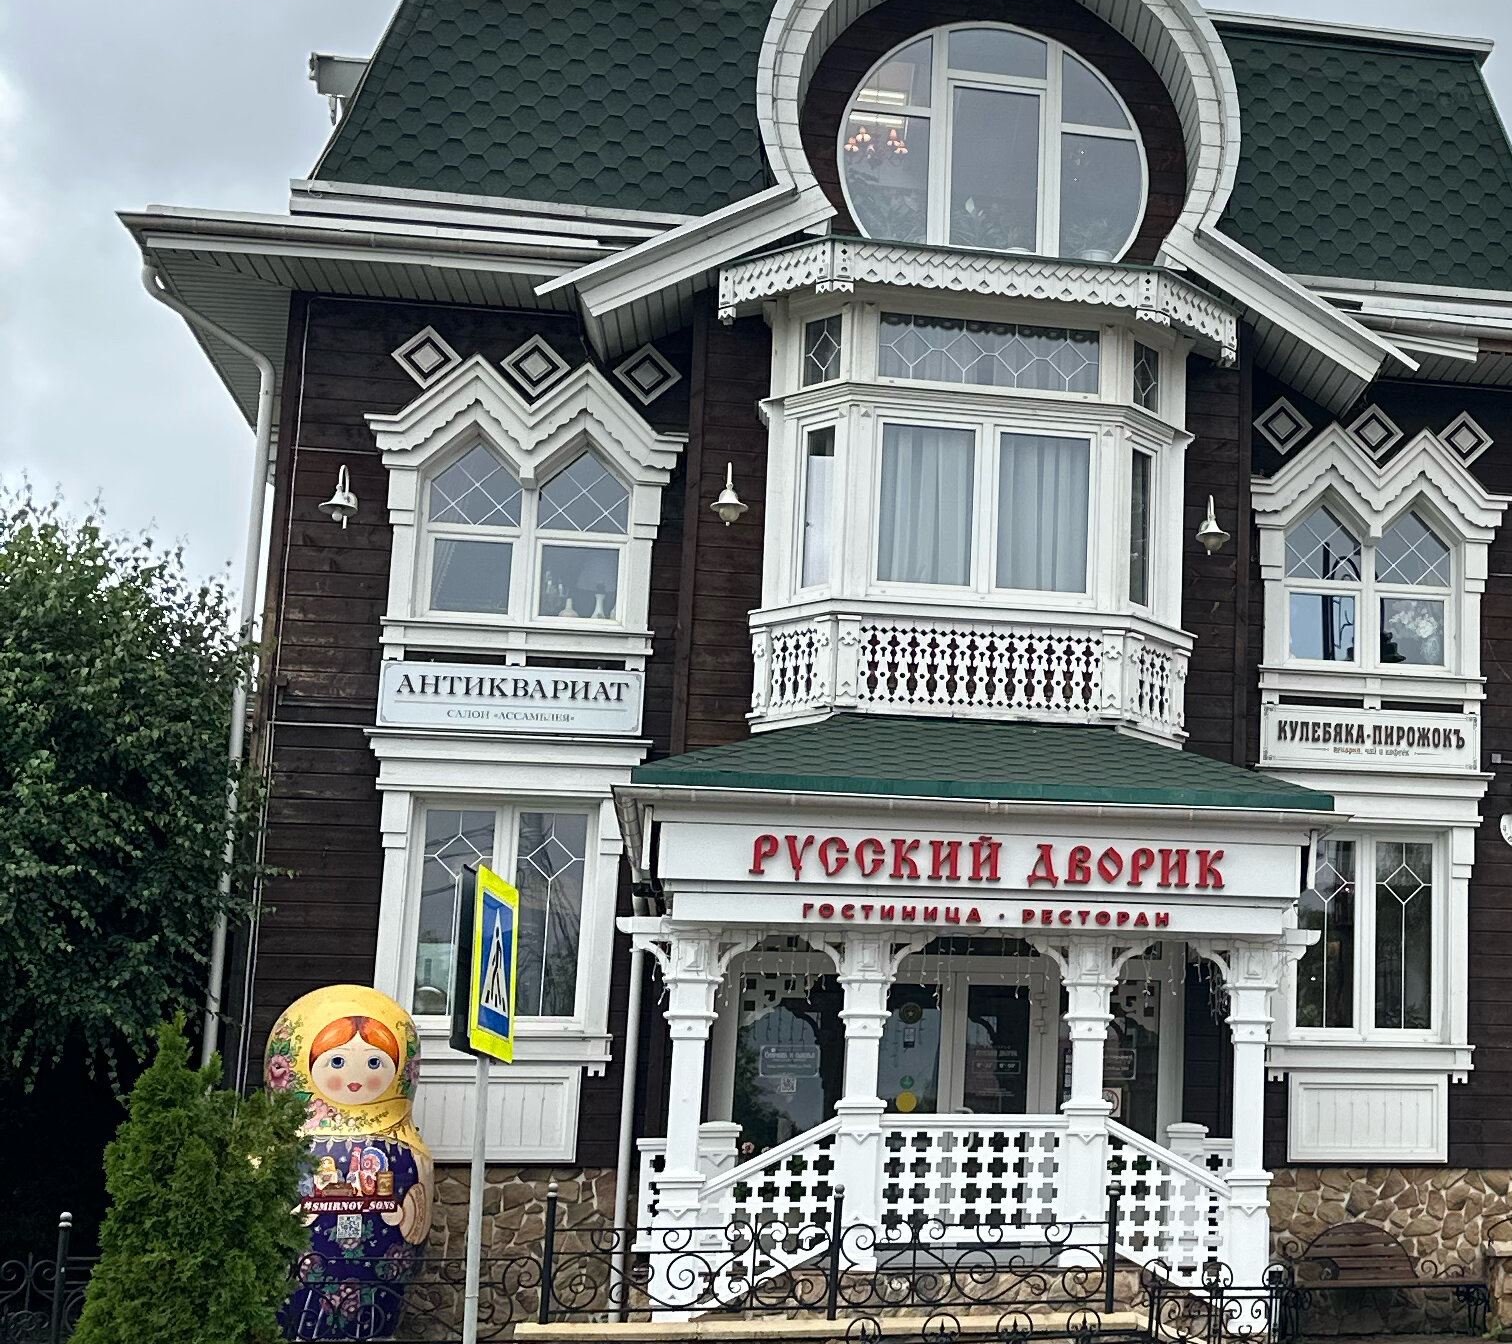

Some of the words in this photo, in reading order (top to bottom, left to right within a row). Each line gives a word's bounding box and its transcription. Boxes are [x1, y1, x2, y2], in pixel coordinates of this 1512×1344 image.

[396, 674, 629, 702] АНТИКВАРИАТ
[447, 709, 490, 720] САЛОН
[748, 833, 1002, 881] РУССКИЙ
[1027, 843, 1225, 888] ДВОРИК
[802, 903, 981, 924] ГОСТИНИЦА
[1022, 908, 1170, 927] РЕСТОРАН
[303, 1200, 395, 1212] #SMIRNOV_SONS
